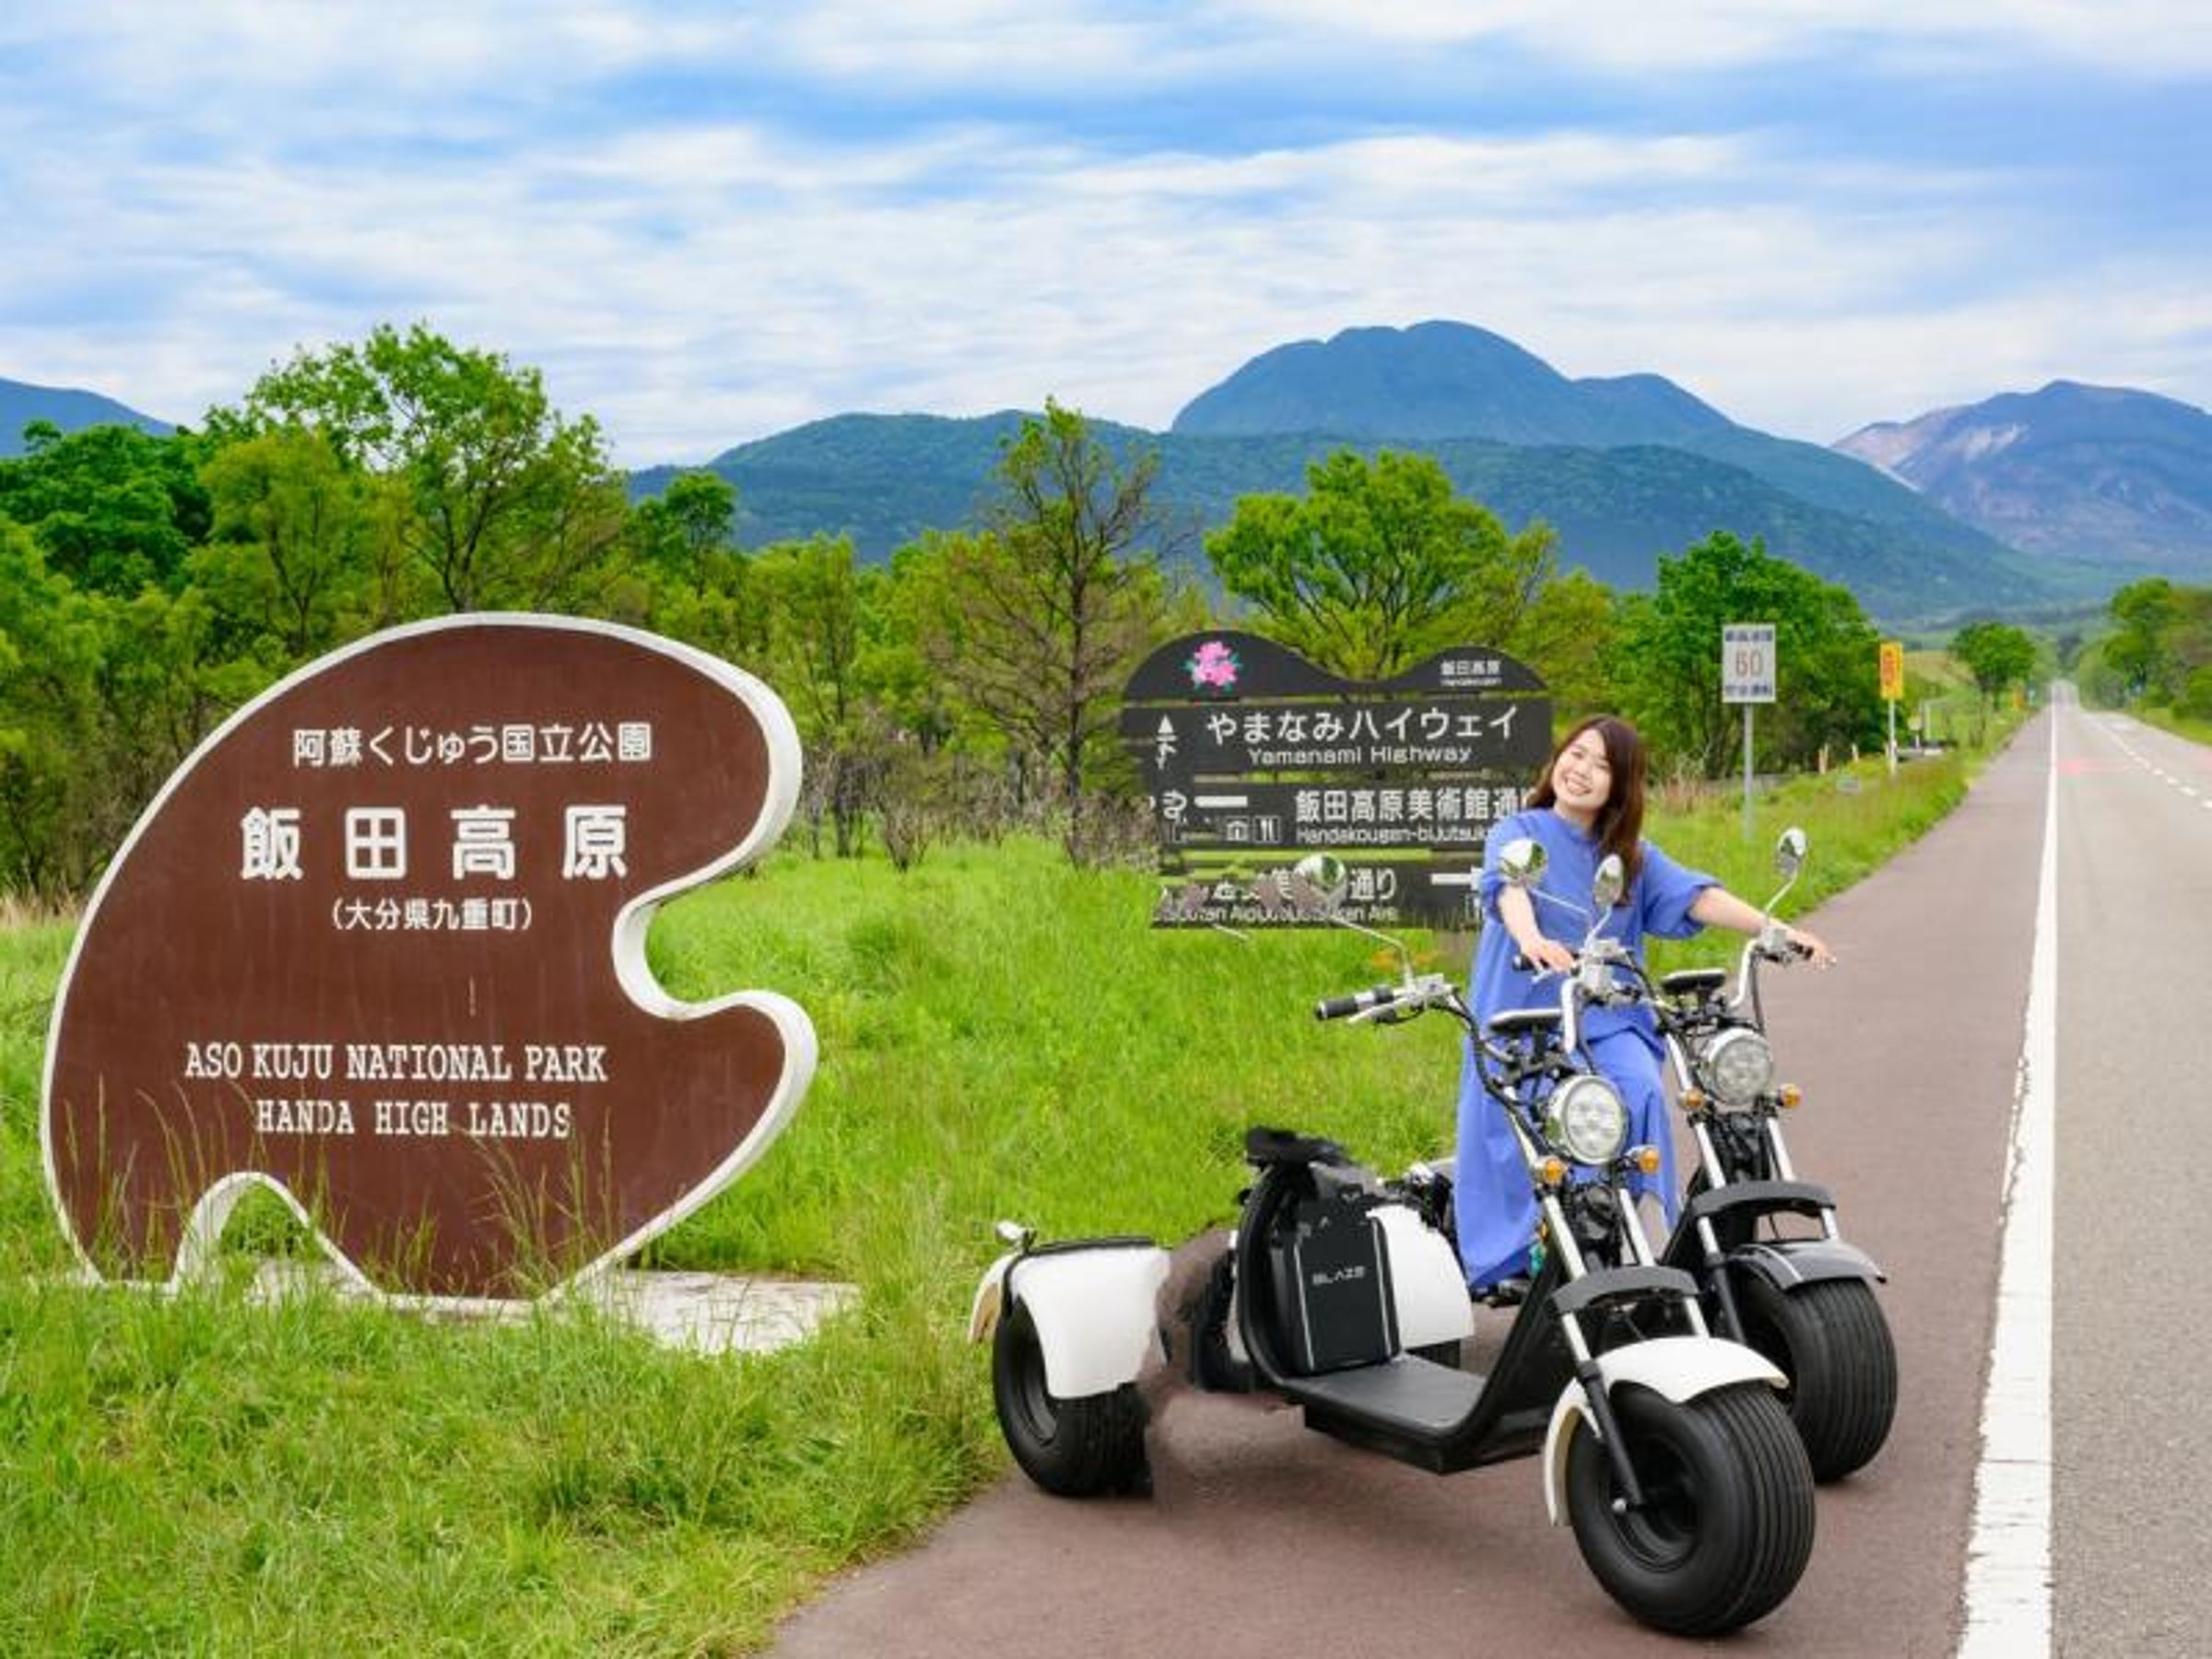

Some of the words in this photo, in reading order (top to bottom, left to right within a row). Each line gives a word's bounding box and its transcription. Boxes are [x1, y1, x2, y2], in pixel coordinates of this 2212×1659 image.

[293, 723, 652, 767] 阿蘇くじゅう国立公園
[1206, 706, 1518, 745] やまなみハイウェイ
[1248, 747, 1361, 764] Yamanami
[1371, 746, 1472, 764] Highway
[240, 805, 629, 880] 飯田高原
[184, 1042, 242, 1078] ASO
[252, 1043, 333, 1079] KUJU
[346, 1044, 512, 1081] NATIONAL
[524, 1045, 608, 1082] PARK
[256, 1100, 355, 1135] HANDA
[375, 1102, 449, 1135] HIGH
[469, 1102, 571, 1138] LANDS
